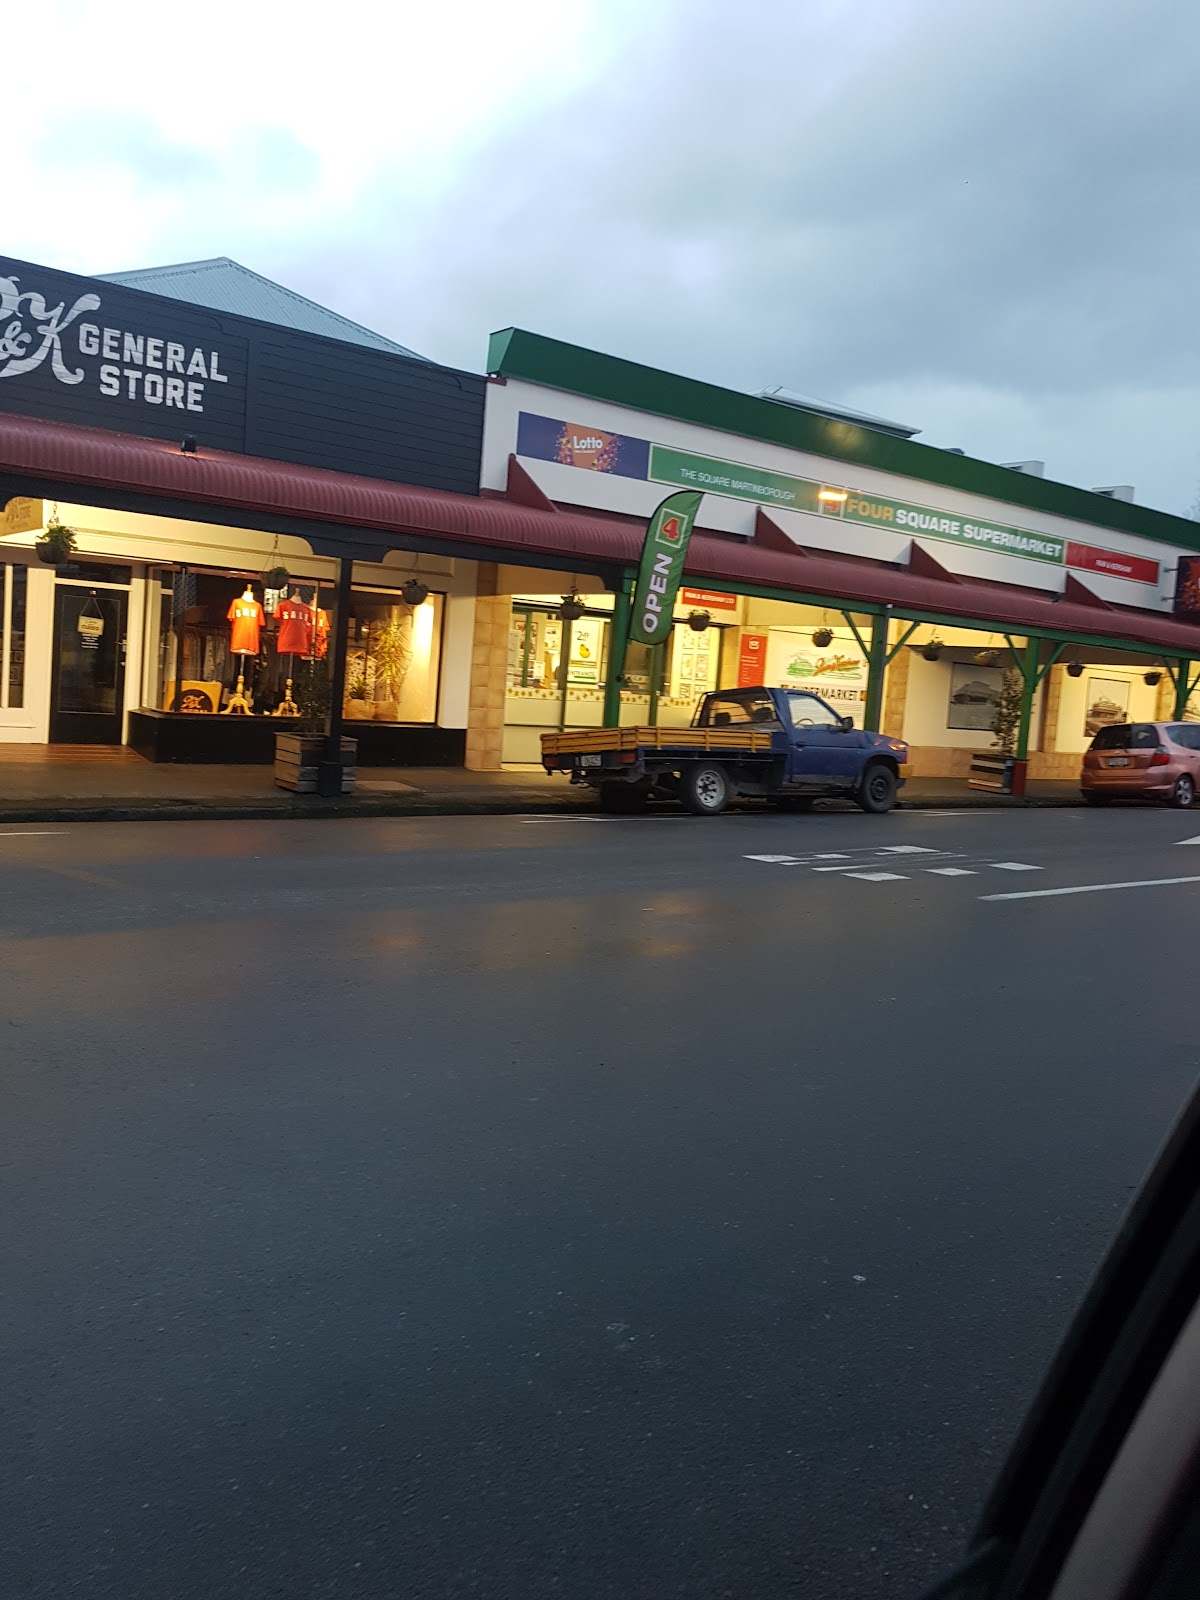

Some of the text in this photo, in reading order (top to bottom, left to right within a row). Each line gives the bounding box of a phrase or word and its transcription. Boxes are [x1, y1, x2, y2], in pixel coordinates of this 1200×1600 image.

[79, 323, 228, 384] GENERAL
[100, 365, 205, 413] STORE
[571, 436, 603, 449] Lotto
[681, 469, 796, 500] THE SQUARE MARTINBOROUGH
[847, 498, 895, 521] FOUR
[895, 509, 961, 538] SQUARE
[962, 523, 1062, 556] SUPERMARKET
[642, 553, 673, 633] OPEN
